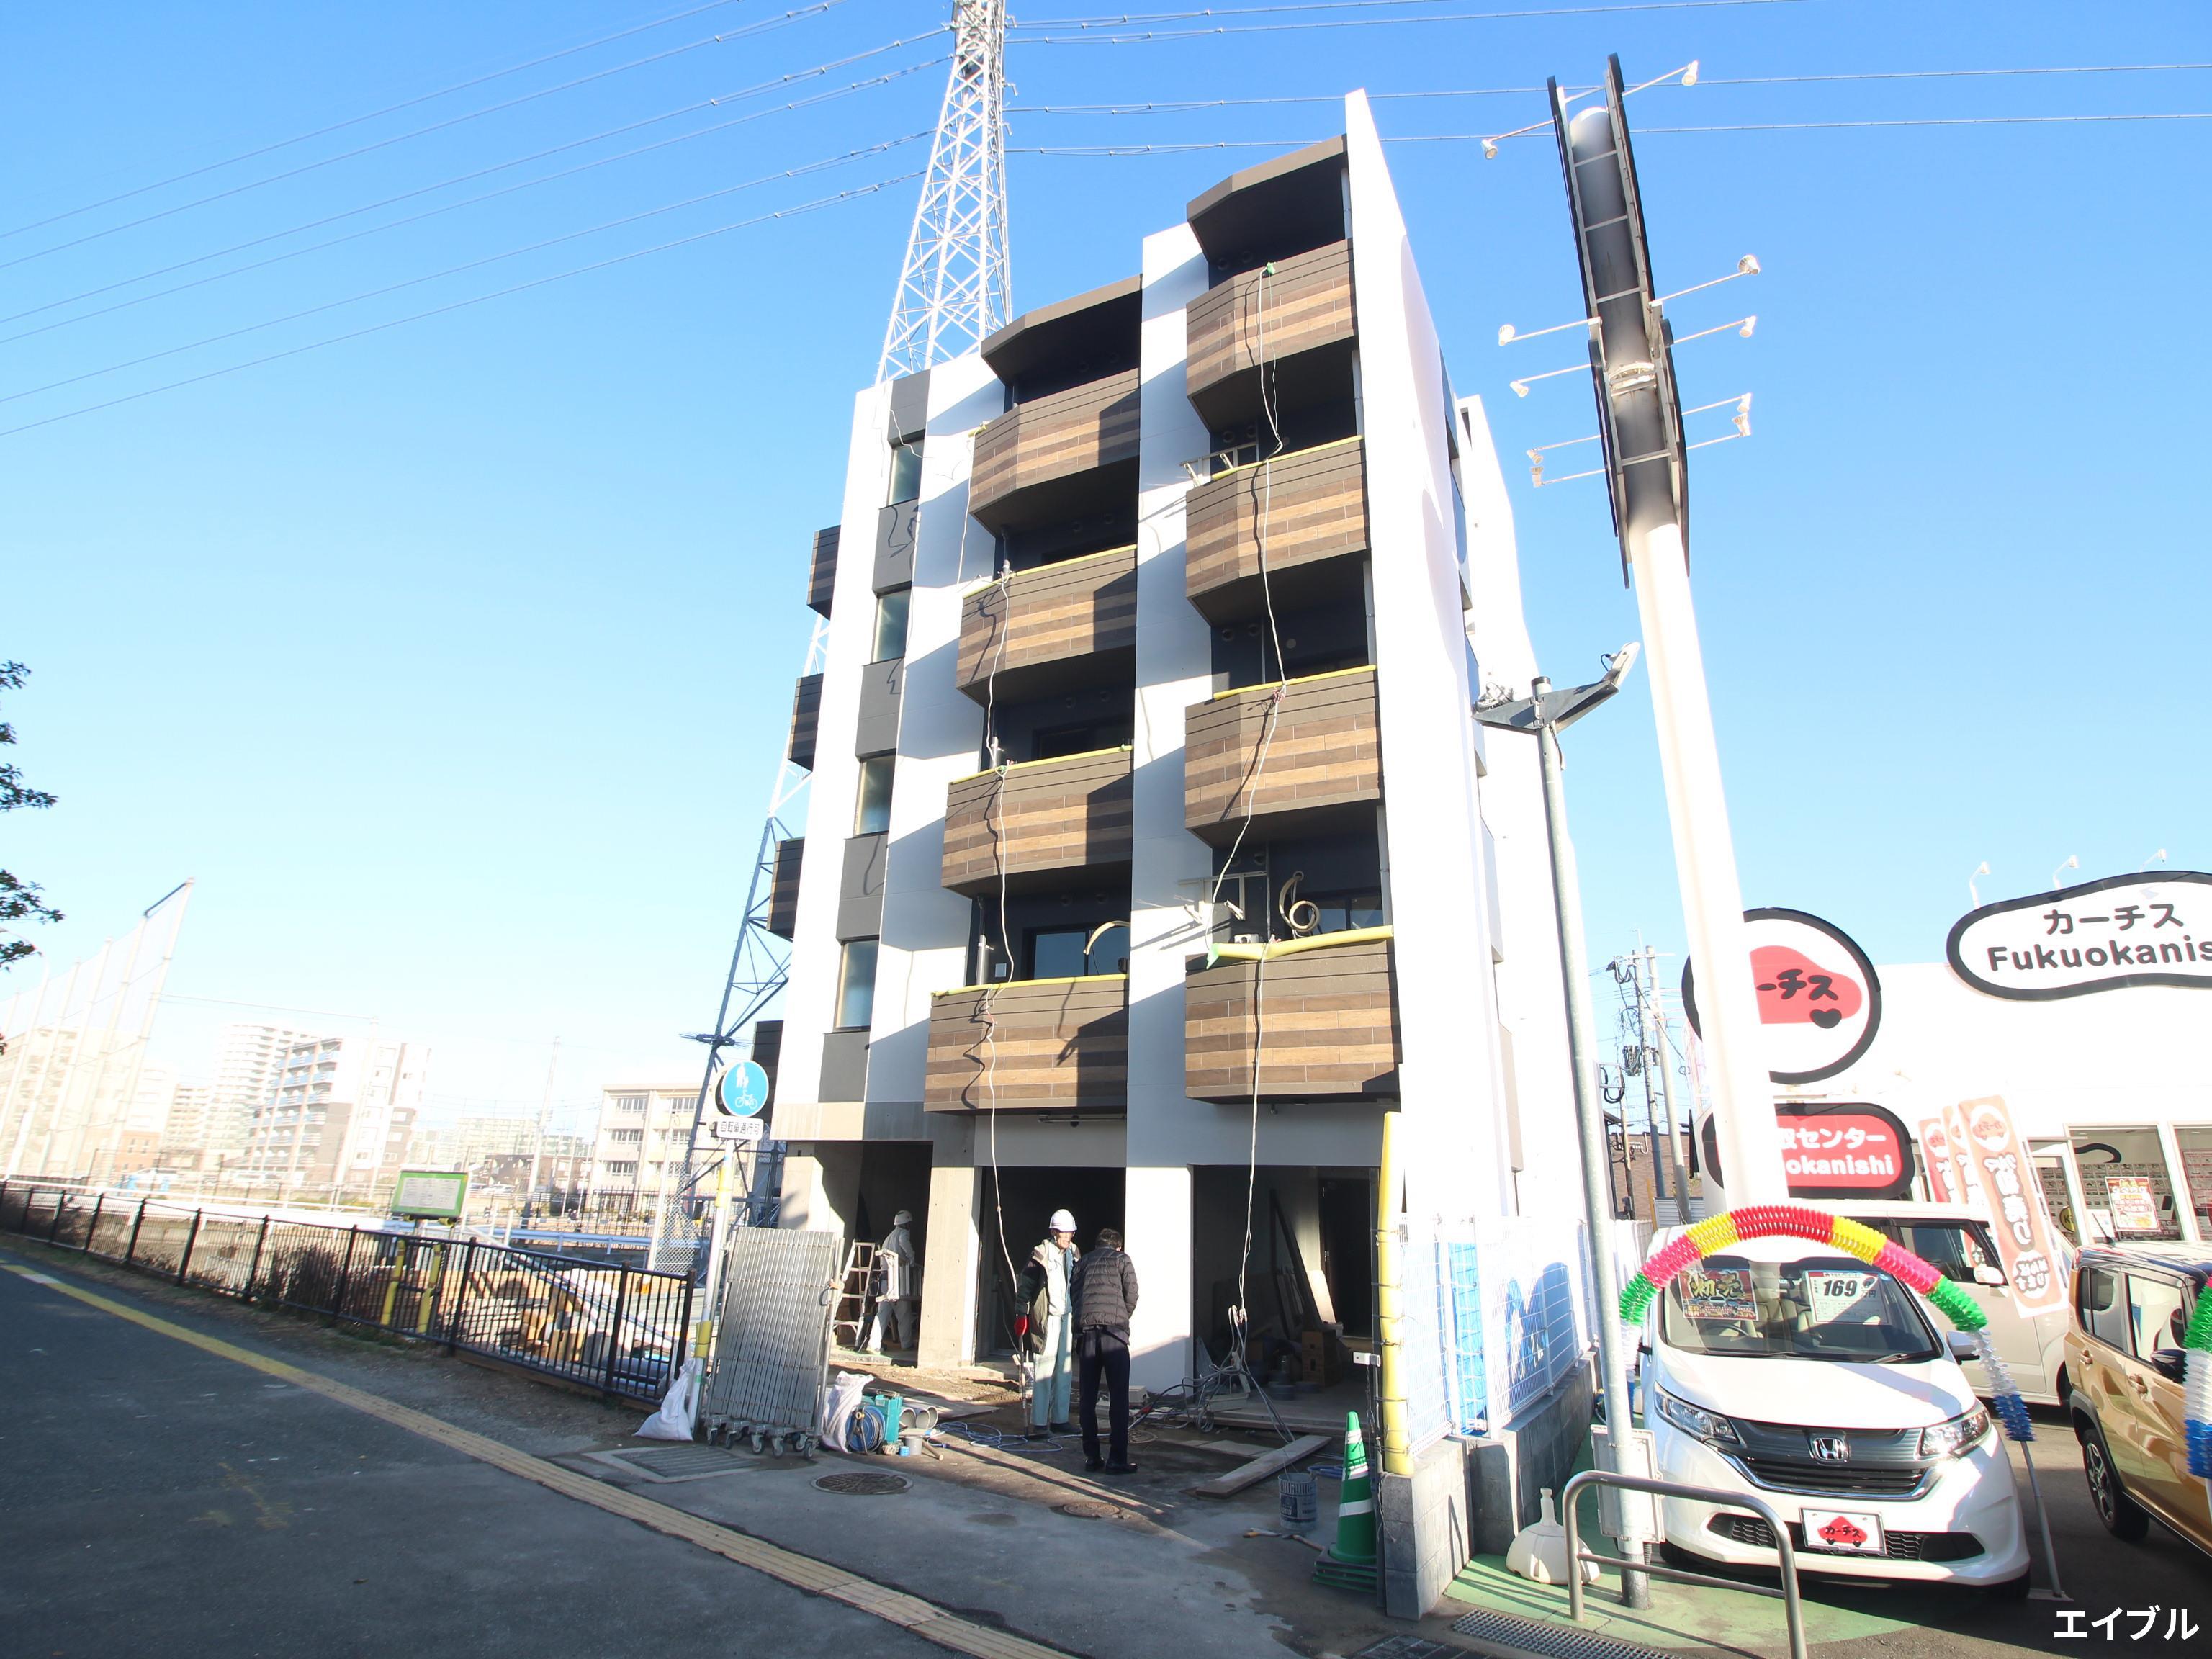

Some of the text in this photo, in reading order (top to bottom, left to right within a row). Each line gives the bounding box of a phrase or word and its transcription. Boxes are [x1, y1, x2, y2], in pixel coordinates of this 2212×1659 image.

[2043, 904, 2184, 935] カーチス
[1786, 1154, 1894, 1175] okanishi
[1824, 1280, 1858, 1297] 169
[1825, 1525, 1861, 1539] カーチス
